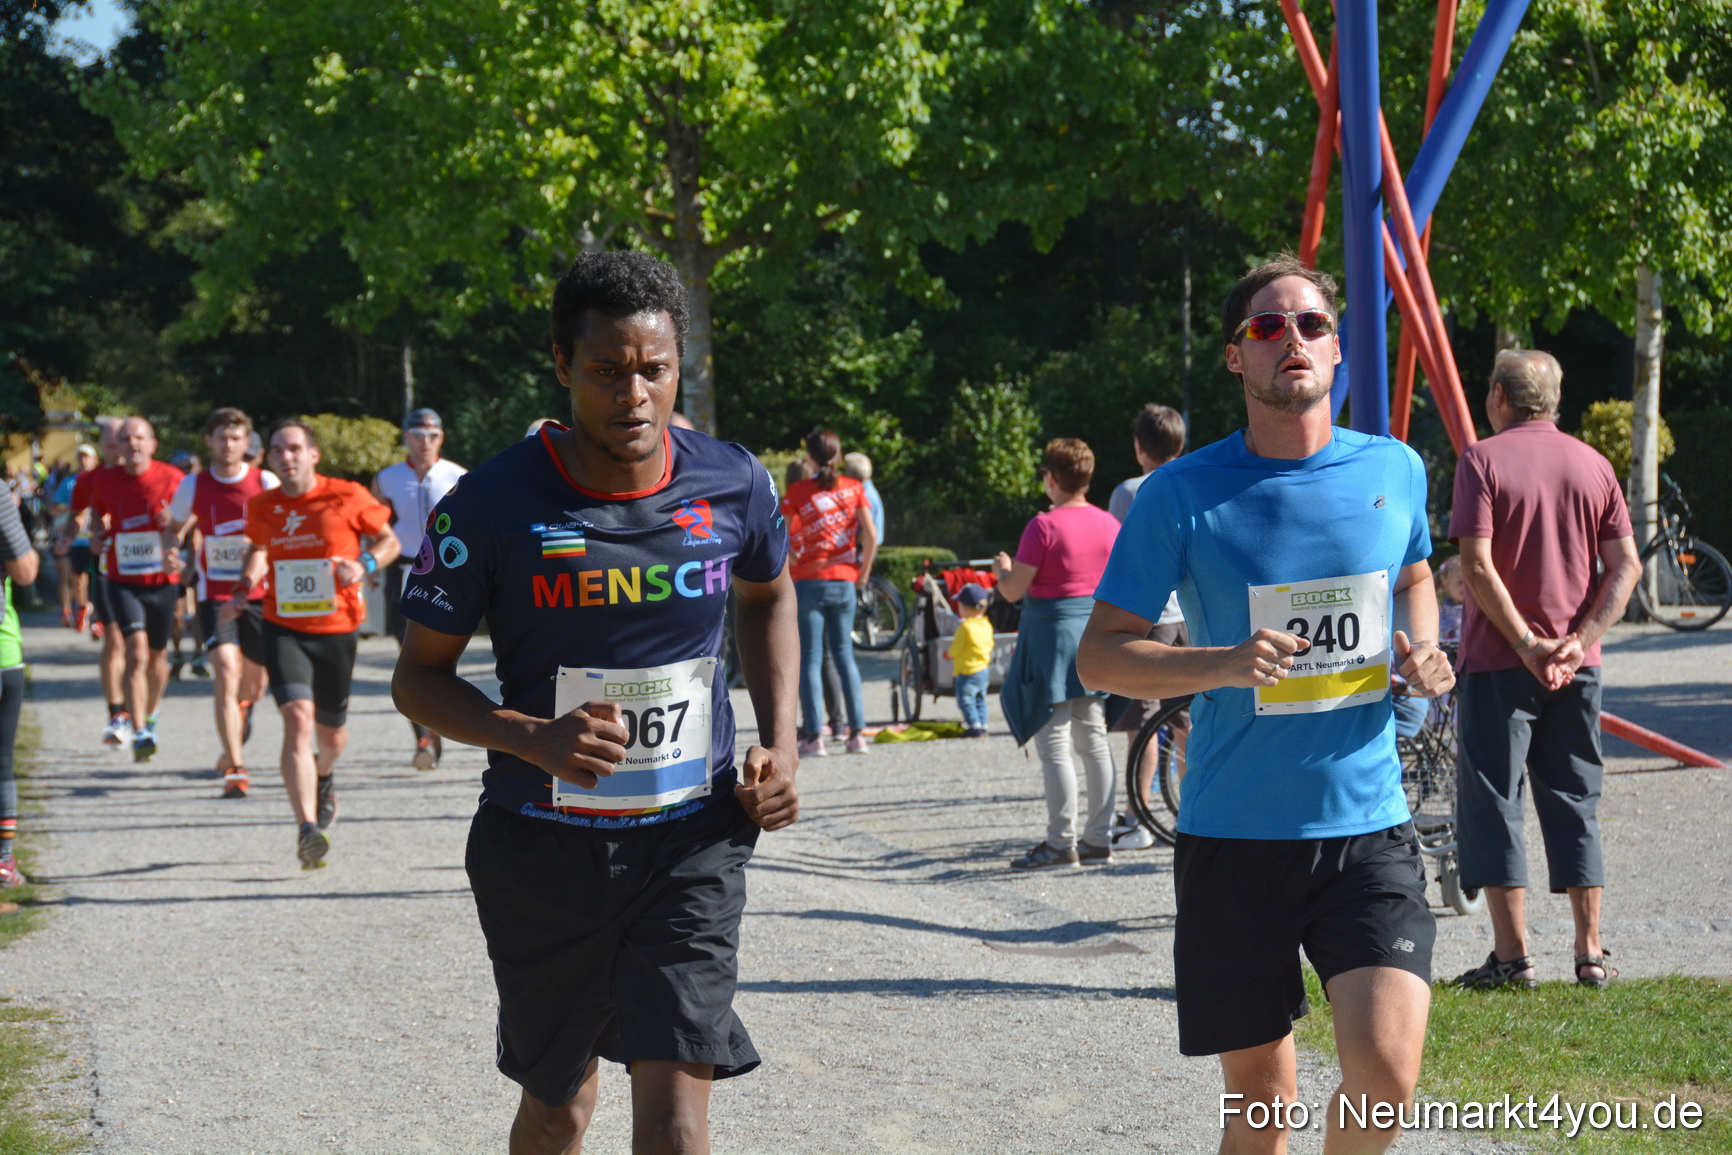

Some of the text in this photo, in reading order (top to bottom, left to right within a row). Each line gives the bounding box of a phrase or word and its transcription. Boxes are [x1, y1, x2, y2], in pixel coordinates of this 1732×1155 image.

[294, 576, 315, 593] 80
[532, 558, 728, 608] MENSCH
[431, 585, 454, 613] Tiere
[1291, 588, 1352, 607] BOCK
[1286, 612, 1360, 657] 340
[1287, 658, 1354, 672] ARTL Neumarkt
[605, 678, 673, 697] BOCK
[626, 753, 669, 765] Neumarkt
